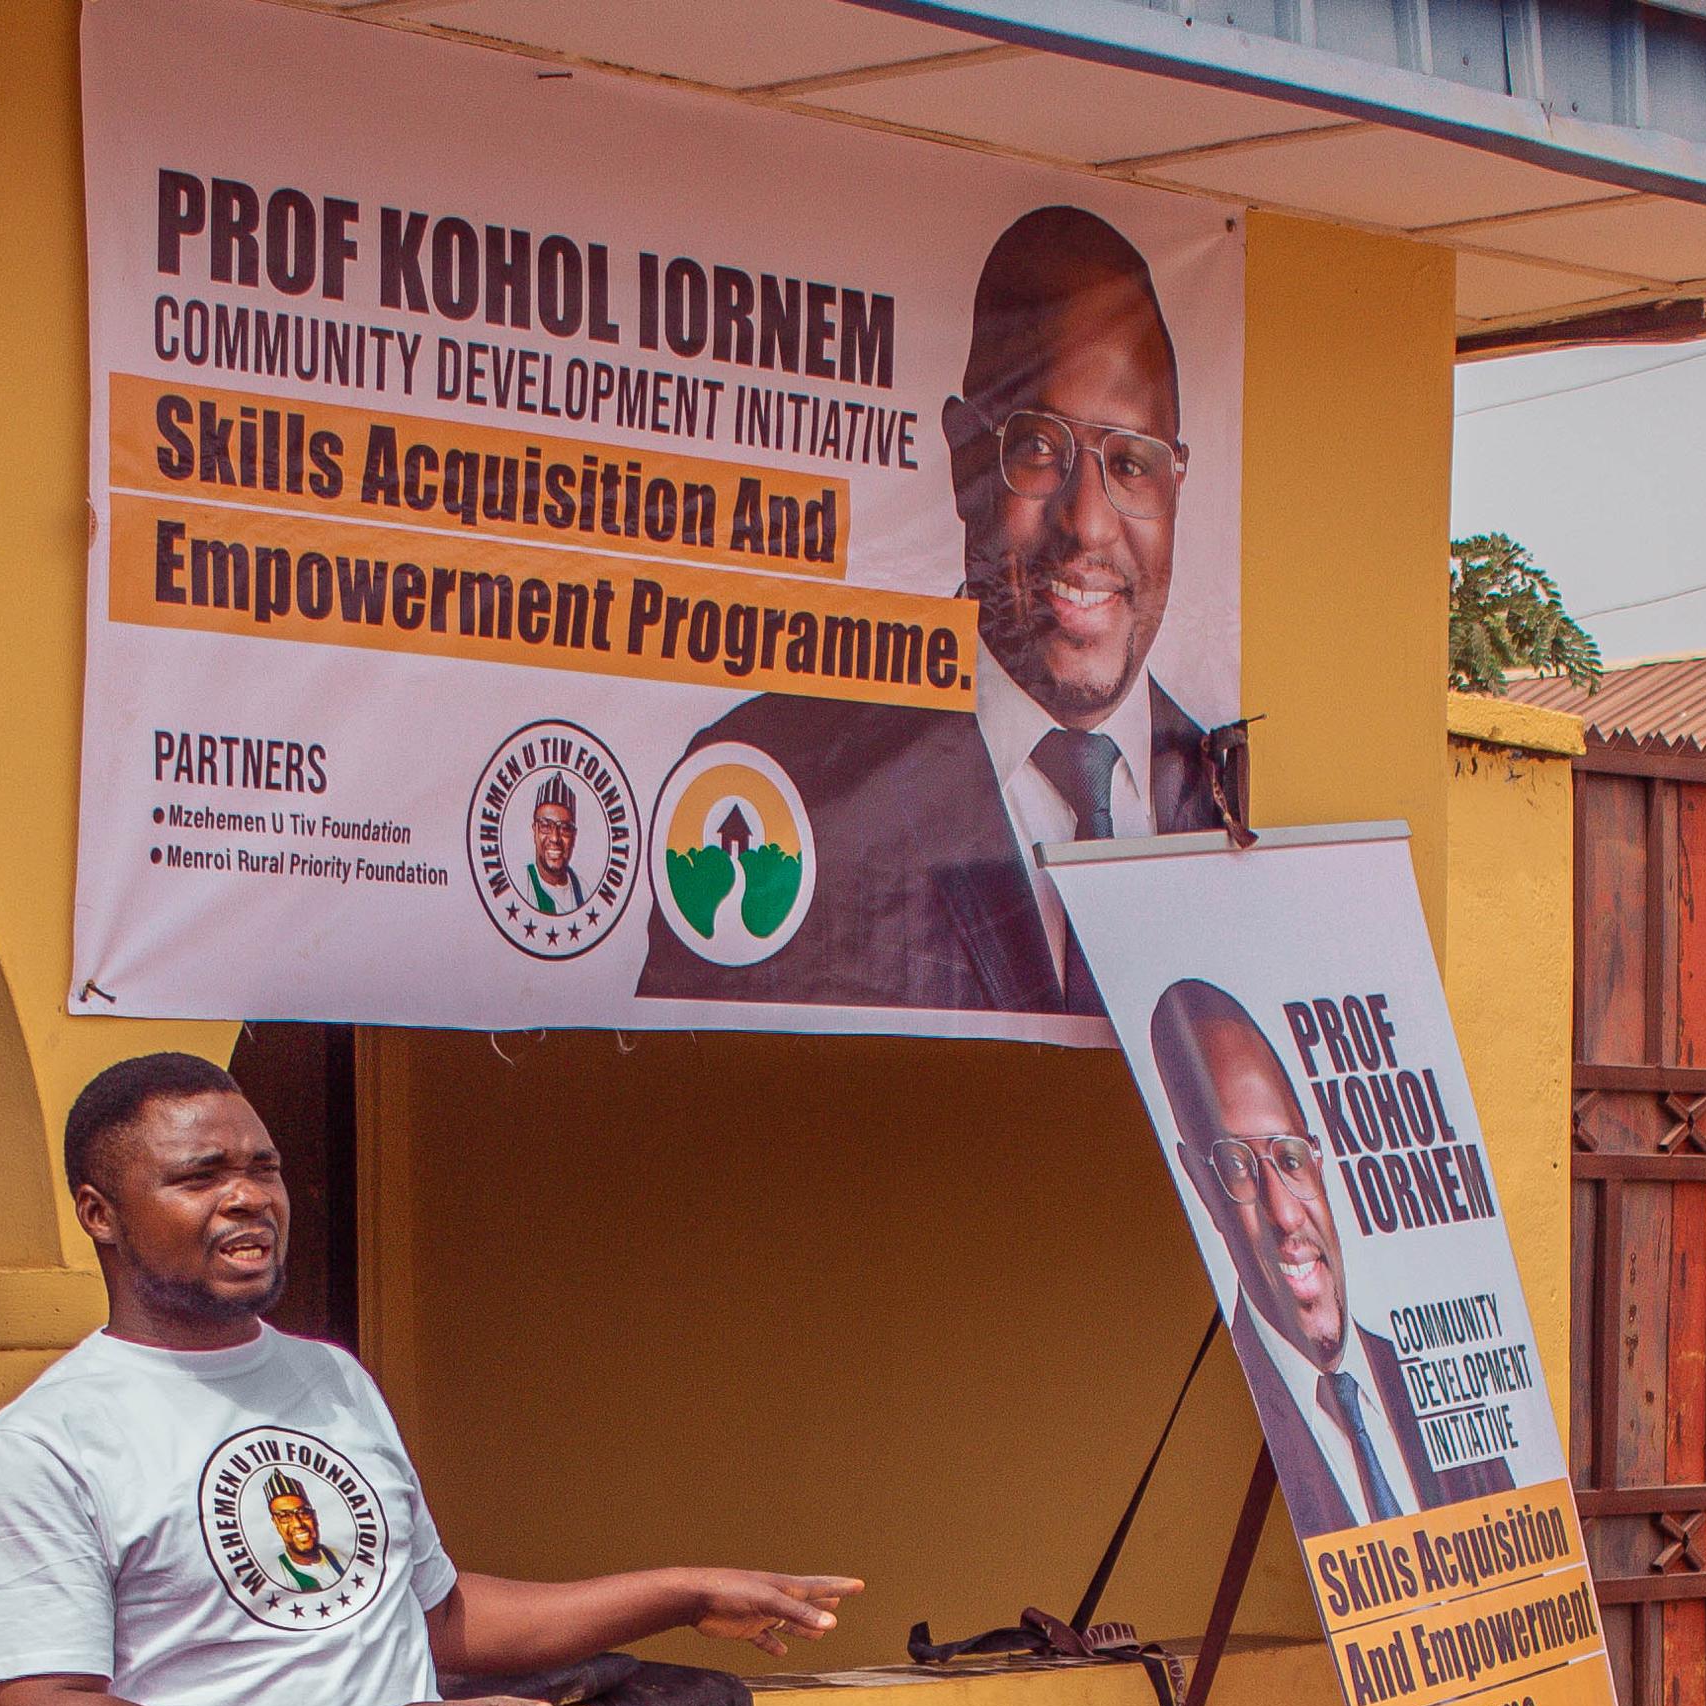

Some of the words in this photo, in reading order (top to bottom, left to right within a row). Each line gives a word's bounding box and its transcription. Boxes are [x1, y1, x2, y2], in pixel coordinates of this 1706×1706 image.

[158, 168, 359, 299] PROF
[379, 206, 620, 345] KOHOL
[638, 250, 895, 390] IORNEM
[154, 294, 422, 396] COMMUNITY
[436, 337, 725, 441] DEVELOPMENT
[734, 384, 920, 471] INITIATIVE
[155, 393, 344, 500] Skills
[360, 425, 717, 546] Acquisition
[730, 476, 838, 564] And
[155, 518, 613, 653] Empowerment
[628, 579, 974, 692] Programme.
[153, 729, 329, 796] PARTNERS
[167, 845, 231, 871] Menroi
[238, 848, 285, 874] Rural
[290, 852, 352, 885] Priority
[356, 857, 448, 886] Foundation
[169, 804, 266, 833] Mzehemen
[272, 812, 284, 834] U
[290, 813, 316, 837] Tiv
[321, 816, 412, 844] Foundation
[480, 755, 523, 899] MZEHEMEN
[522, 743, 537, 770] U
[540, 737, 573, 766] TIV
[574, 747, 630, 907] FOUNDATION
[1282, 994, 1398, 1078] PROF
[1311, 1068, 1457, 1157] KOHOL
[1339, 1144, 1496, 1237] IORNEM
[1391, 1293, 1504, 1356] COMMUNITY
[1407, 1344, 1533, 1411] DEVELOPMENT
[229, 1453, 252, 1474] U
[245, 1440, 281, 1464] TIV
[1424, 1404, 1519, 1466] INITIATIVE
[213, 1469, 267, 1597] MZEHEMEN
[286, 1442, 378, 1568] FOUNDATION
[1317, 1539, 1419, 1617] Skills
[1413, 1504, 1570, 1593] Acquisition
[1411, 1581, 1598, 1687] Empowerment
